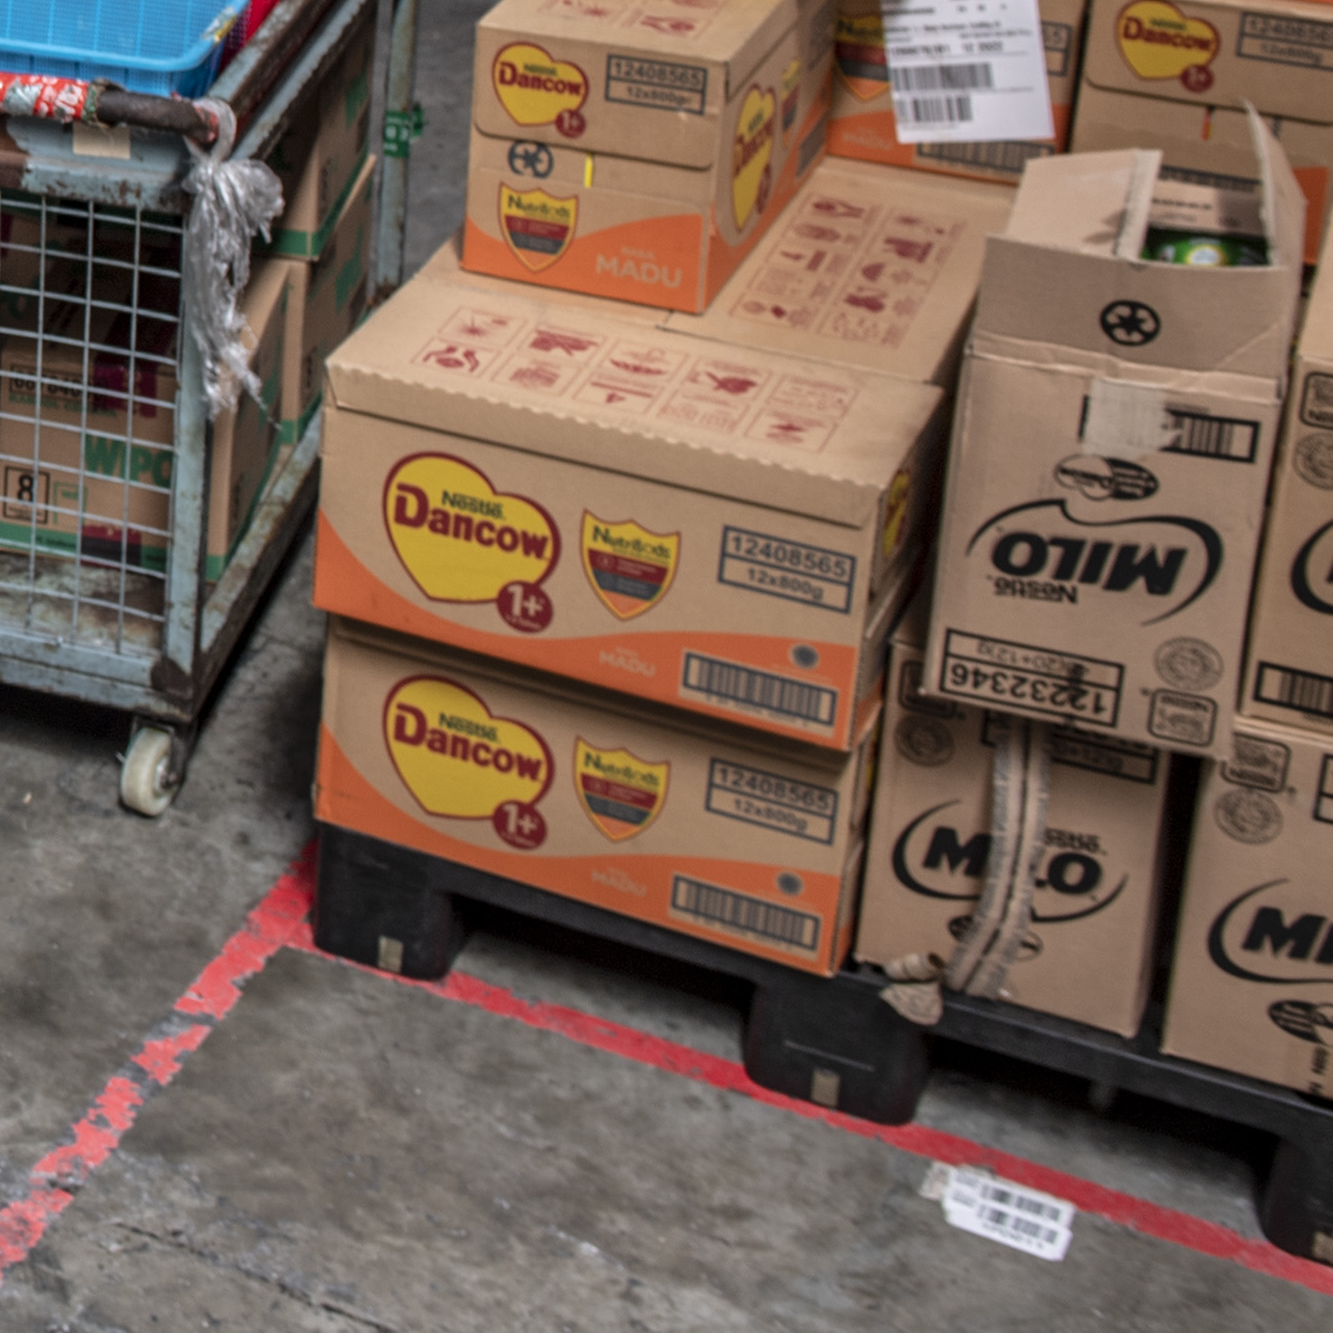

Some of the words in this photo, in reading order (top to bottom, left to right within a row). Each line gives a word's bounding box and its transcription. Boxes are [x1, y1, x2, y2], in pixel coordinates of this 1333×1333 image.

[1120, 16, 1212, 54] Dancow
[499, 61, 583, 97] Dancow
[614, 61, 701, 87] 12408565
[595, 254, 684, 289] MADU
[393, 482, 551, 561] Dancow
[729, 534, 849, 580] 12408565
[991, 533, 1188, 597] MILO
[745, 565, 824, 601] 12x800g
[598, 650, 656, 678] MADU
[950, 662, 1106, 715] 12232346
[393, 703, 543, 782] Dancow
[717, 766, 832, 813] 12408565
[730, 795, 808, 833] 12x800g
[1241, 906, 1333, 966] MI
